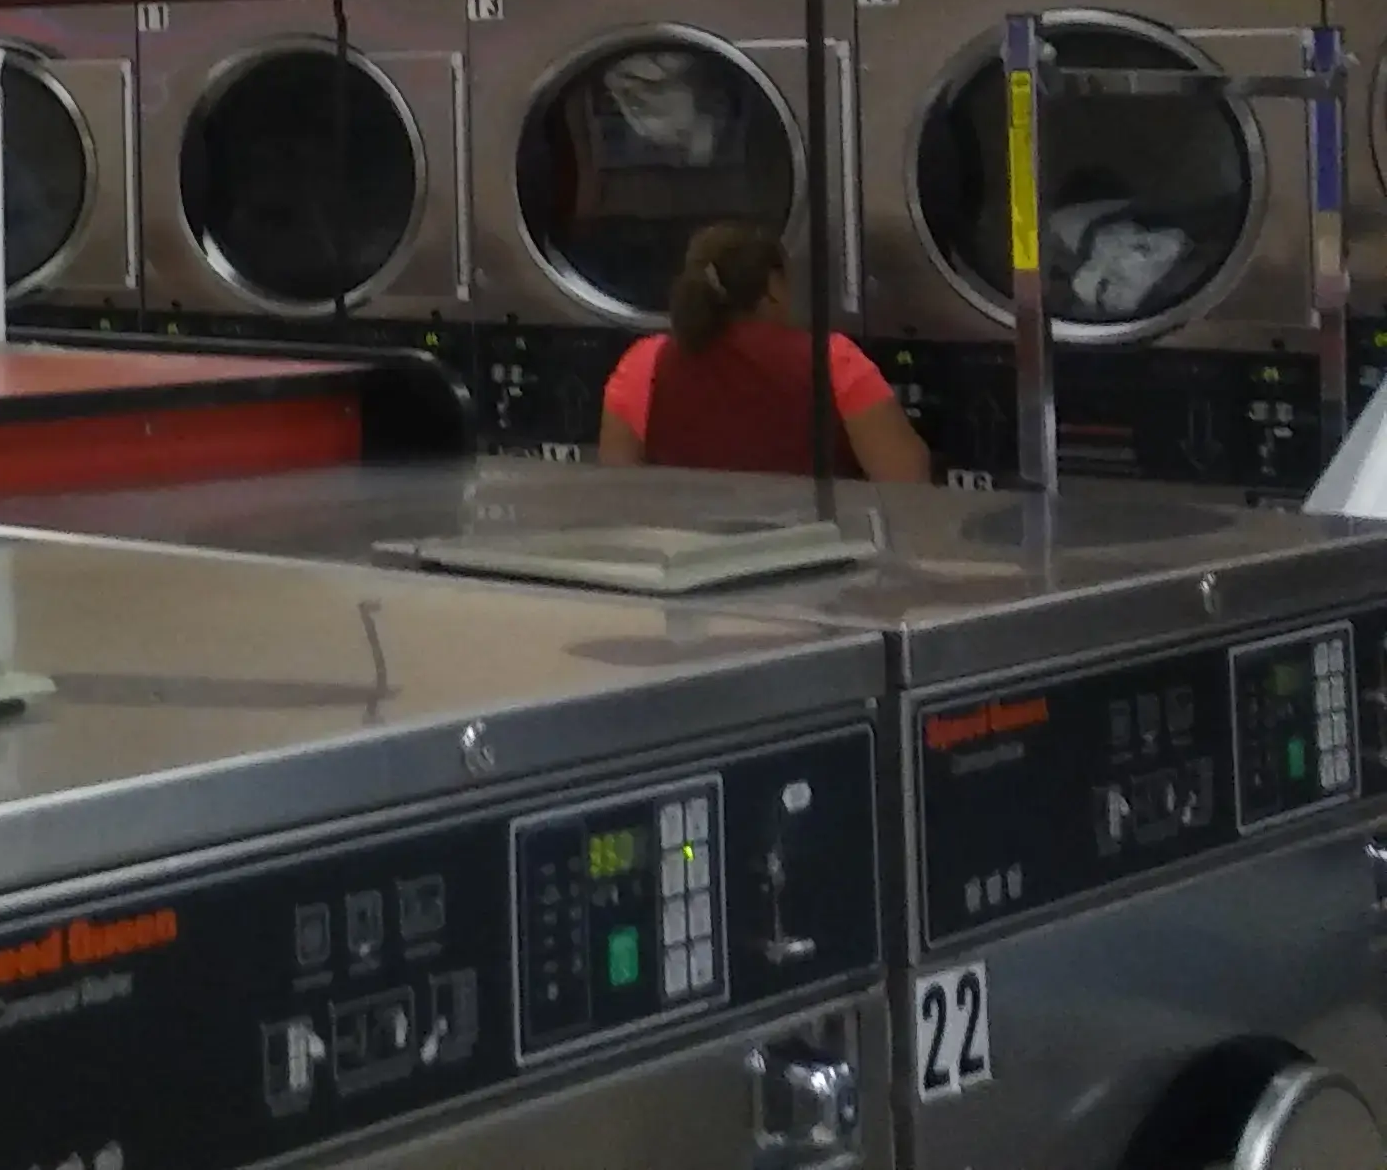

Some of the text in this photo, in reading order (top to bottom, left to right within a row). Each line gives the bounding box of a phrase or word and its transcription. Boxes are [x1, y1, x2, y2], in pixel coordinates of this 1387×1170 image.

[142, 5, 166, 28] 11
[68, 907, 178, 964] Queen
[922, 968, 986, 1090] 22
